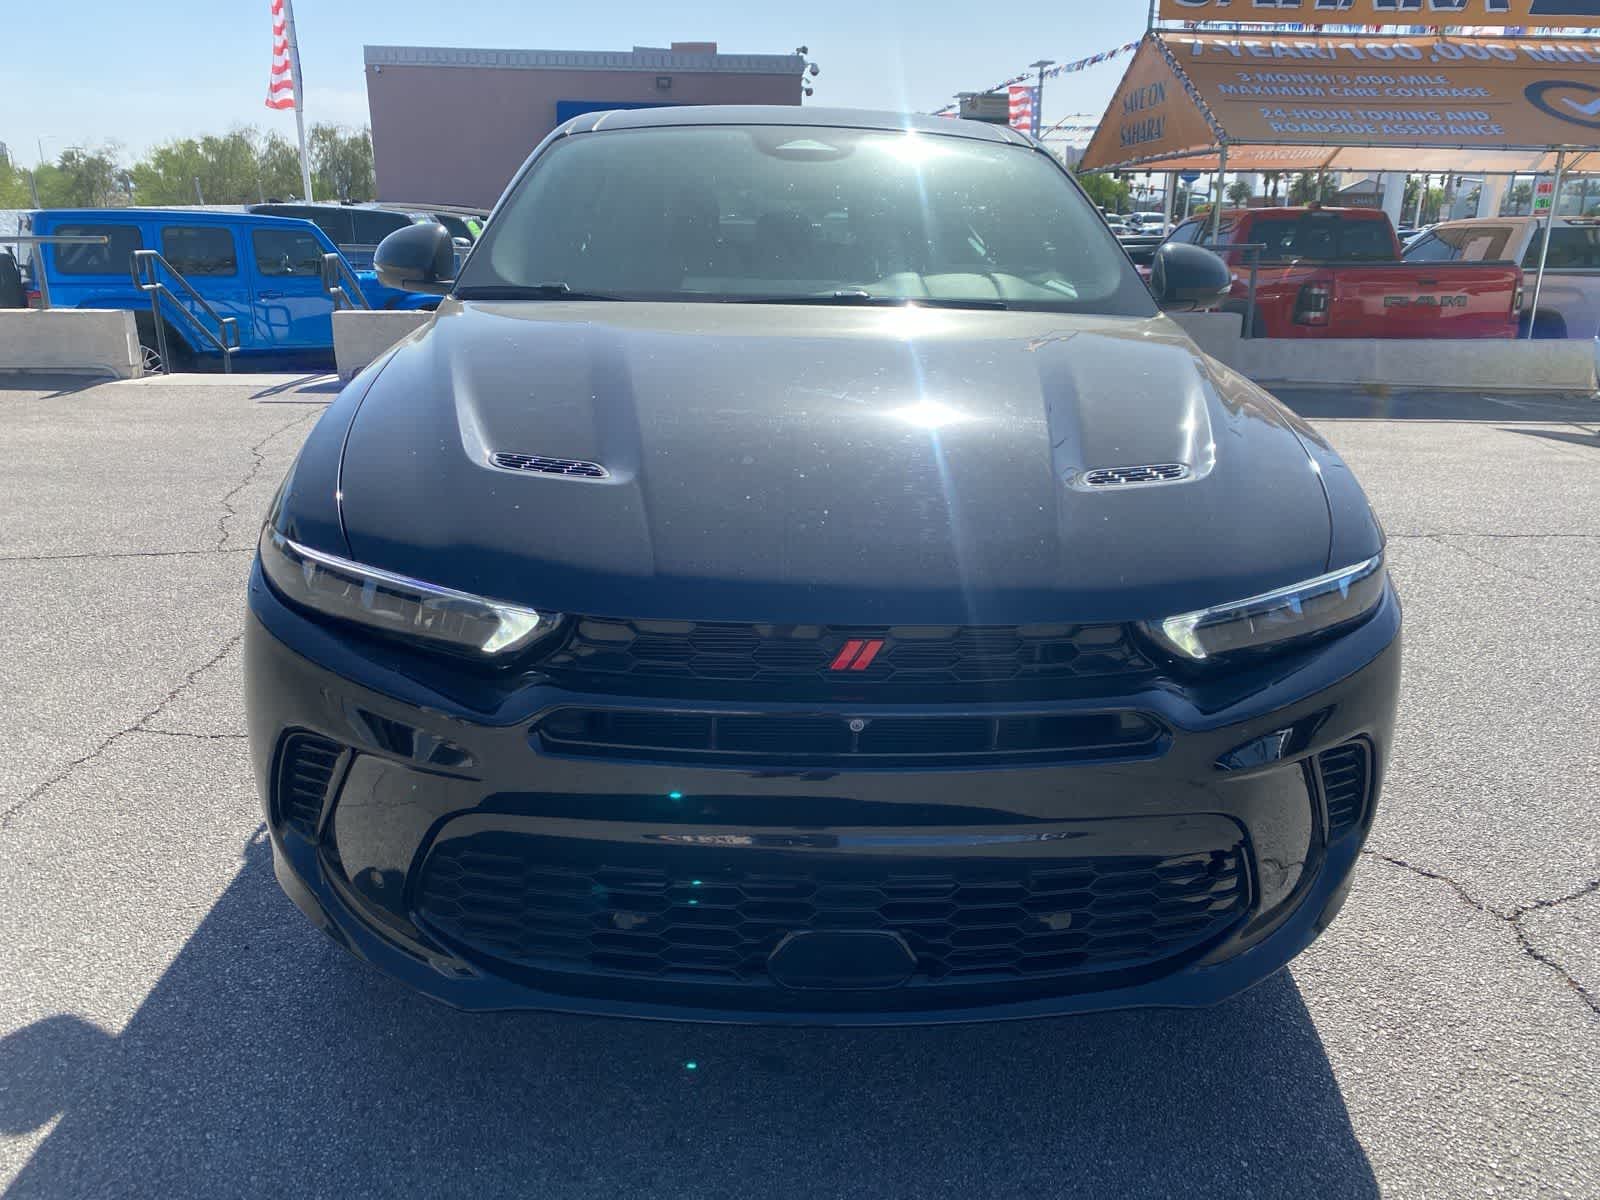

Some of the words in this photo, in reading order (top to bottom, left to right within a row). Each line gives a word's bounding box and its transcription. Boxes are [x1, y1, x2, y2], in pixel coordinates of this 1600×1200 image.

[1518, 44, 1600, 64] MIL
[1218, 83, 1325, 97] MAXIMUM
[1328, 86, 1382, 97] CARE
[1384, 87, 1491, 97] COVERAGE
[1260, 107, 1353, 120] 24-HOUR
[1357, 110, 1441, 121] TOWING
[1444, 111, 1490, 121] AND
[1268, 120, 1378, 134] ROADSIDE
[1380, 123, 1505, 136] ASSISTANCE
[1383, 295, 1468, 308] RAM
